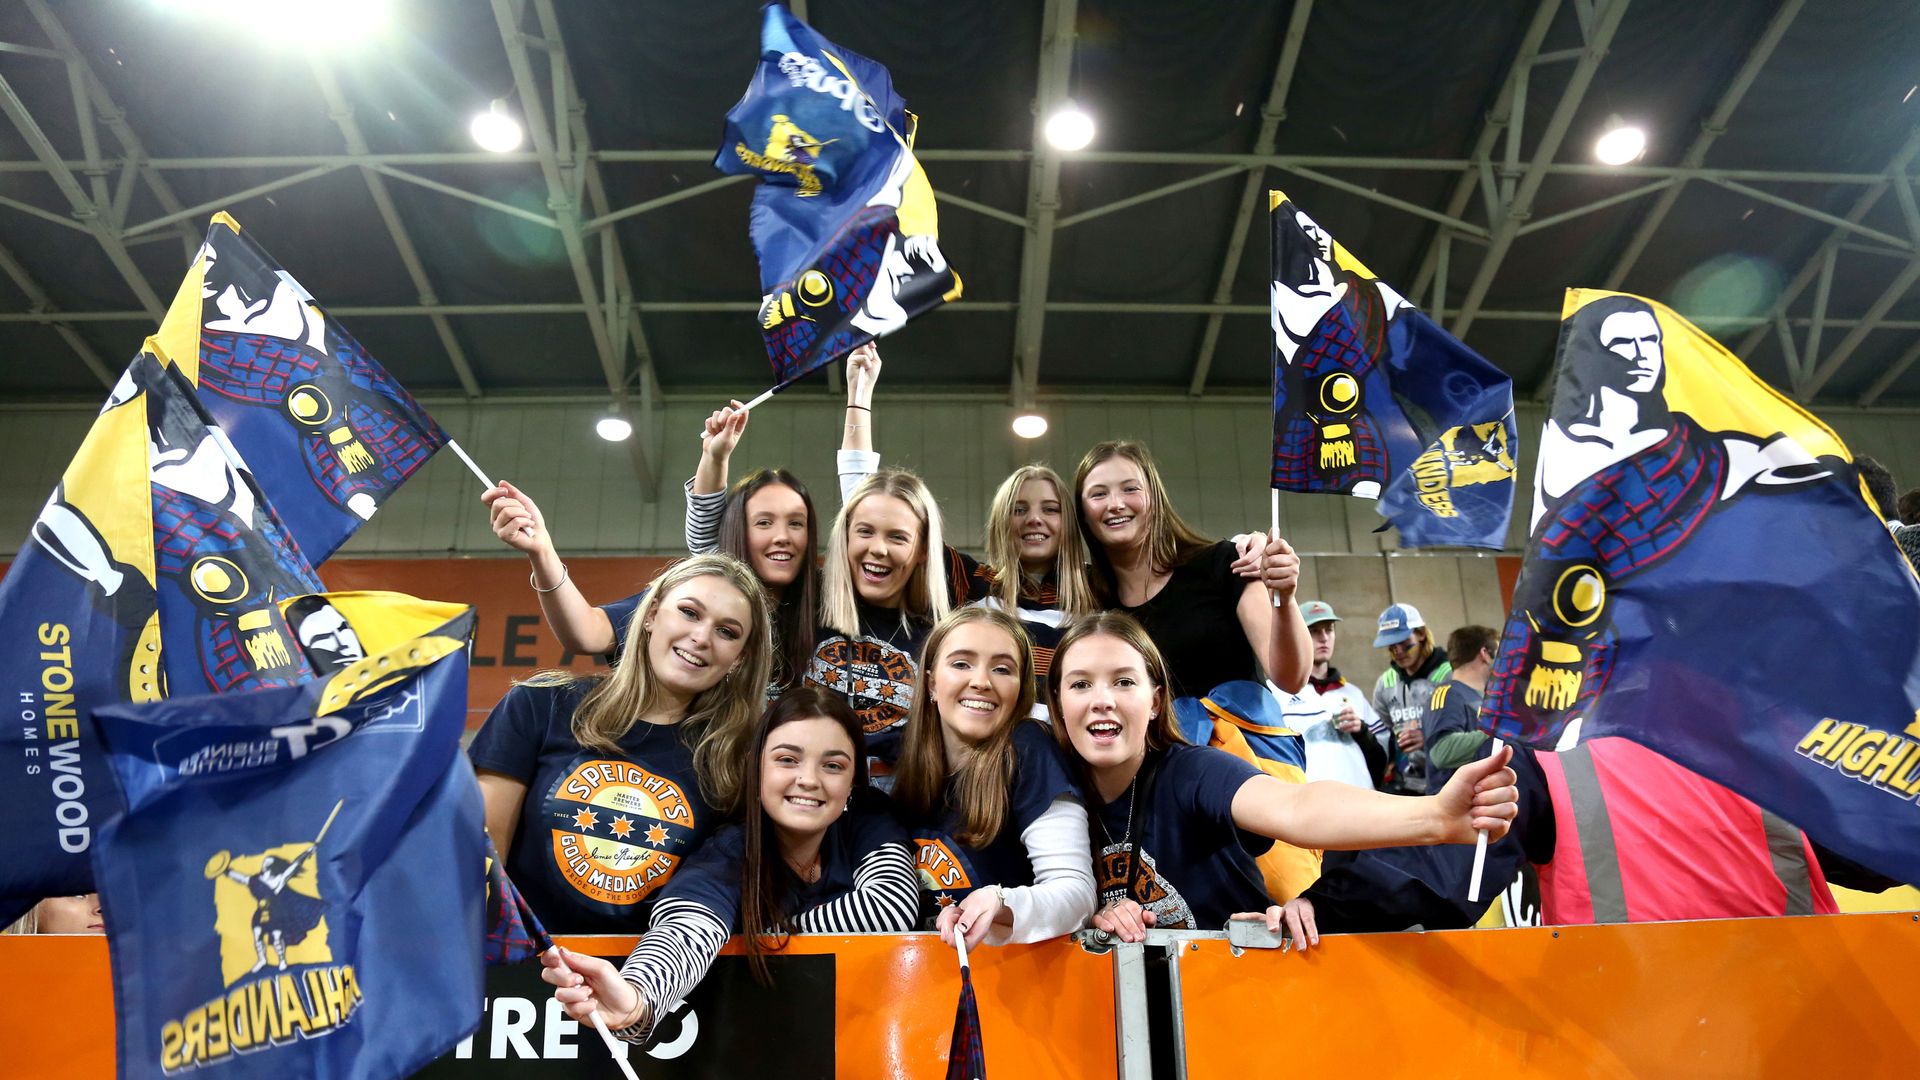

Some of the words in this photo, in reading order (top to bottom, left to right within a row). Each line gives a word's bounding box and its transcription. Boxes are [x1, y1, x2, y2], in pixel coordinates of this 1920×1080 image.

[20, 692, 41, 776] HOMES
[38, 623, 91, 854] STONEWOOD
[566, 763, 689, 821] SPEIGHT'S
[560, 834, 591, 877] GOLD
[587, 868, 646, 893] MEDAL
[646, 853, 673, 882] ALE
[565, 868, 587, 891] PRIDE
[590, 888, 602, 897] OF
[606, 893, 622, 901] THE
[1102, 888, 1128, 899] MAST
